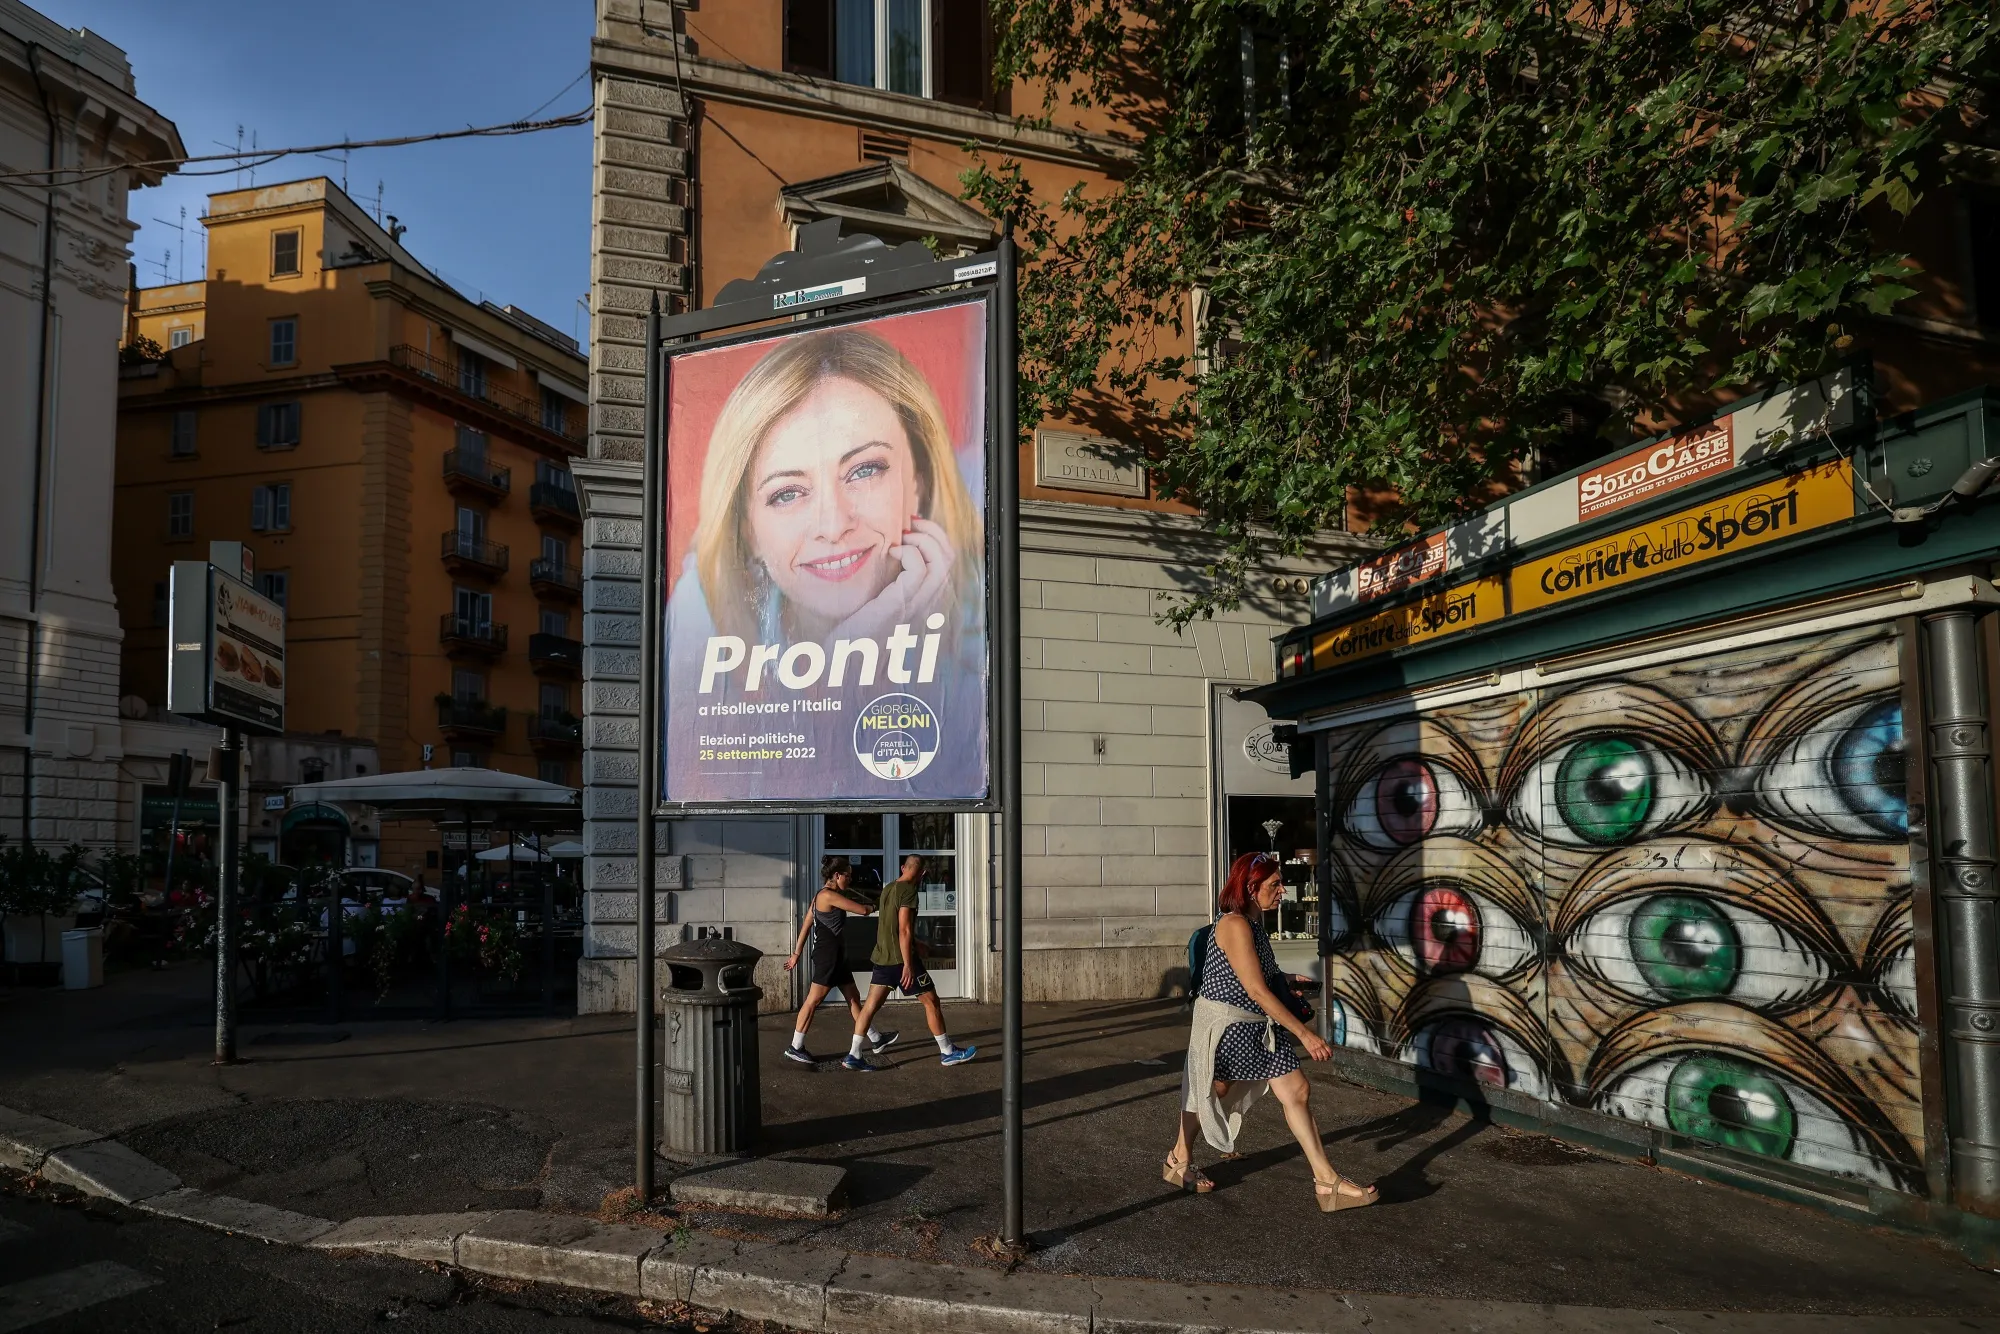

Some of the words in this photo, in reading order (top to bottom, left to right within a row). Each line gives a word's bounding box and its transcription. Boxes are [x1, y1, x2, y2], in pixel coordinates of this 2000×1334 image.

[1062, 464, 1120, 482] D'ITALIA
[1590, 491, 1635, 512] GIORNALE
[1635, 483, 1654, 495] CHE
[1655, 479, 1666, 488] TI
[1667, 467, 1700, 483] TROVA
[1540, 544, 1650, 595] Corriere
[1651, 538, 1695, 566] dello
[1697, 488, 1799, 551] Sport
[1332, 623, 1394, 658] Corriere
[1394, 621, 1421, 641] dello
[1421, 592, 1477, 633] Sport
[698, 612, 946, 695] Pronti
[698, 704, 708, 716] a
[710, 700, 790, 716] risollevare
[792, 697, 842, 714] l'Italia
[871, 703, 922, 715] GIORGIA
[862, 713, 930, 730] MELONI
[699, 733, 747, 747] Elezioni
[748, 732, 806, 748] politiche
[880, 740, 913, 748] FRATELLI
[699, 750, 715, 761] 25
[716, 748, 783, 761] settembre
[785, 747, 816, 759] 2022
[877, 748, 916, 757] d'ITALIA
